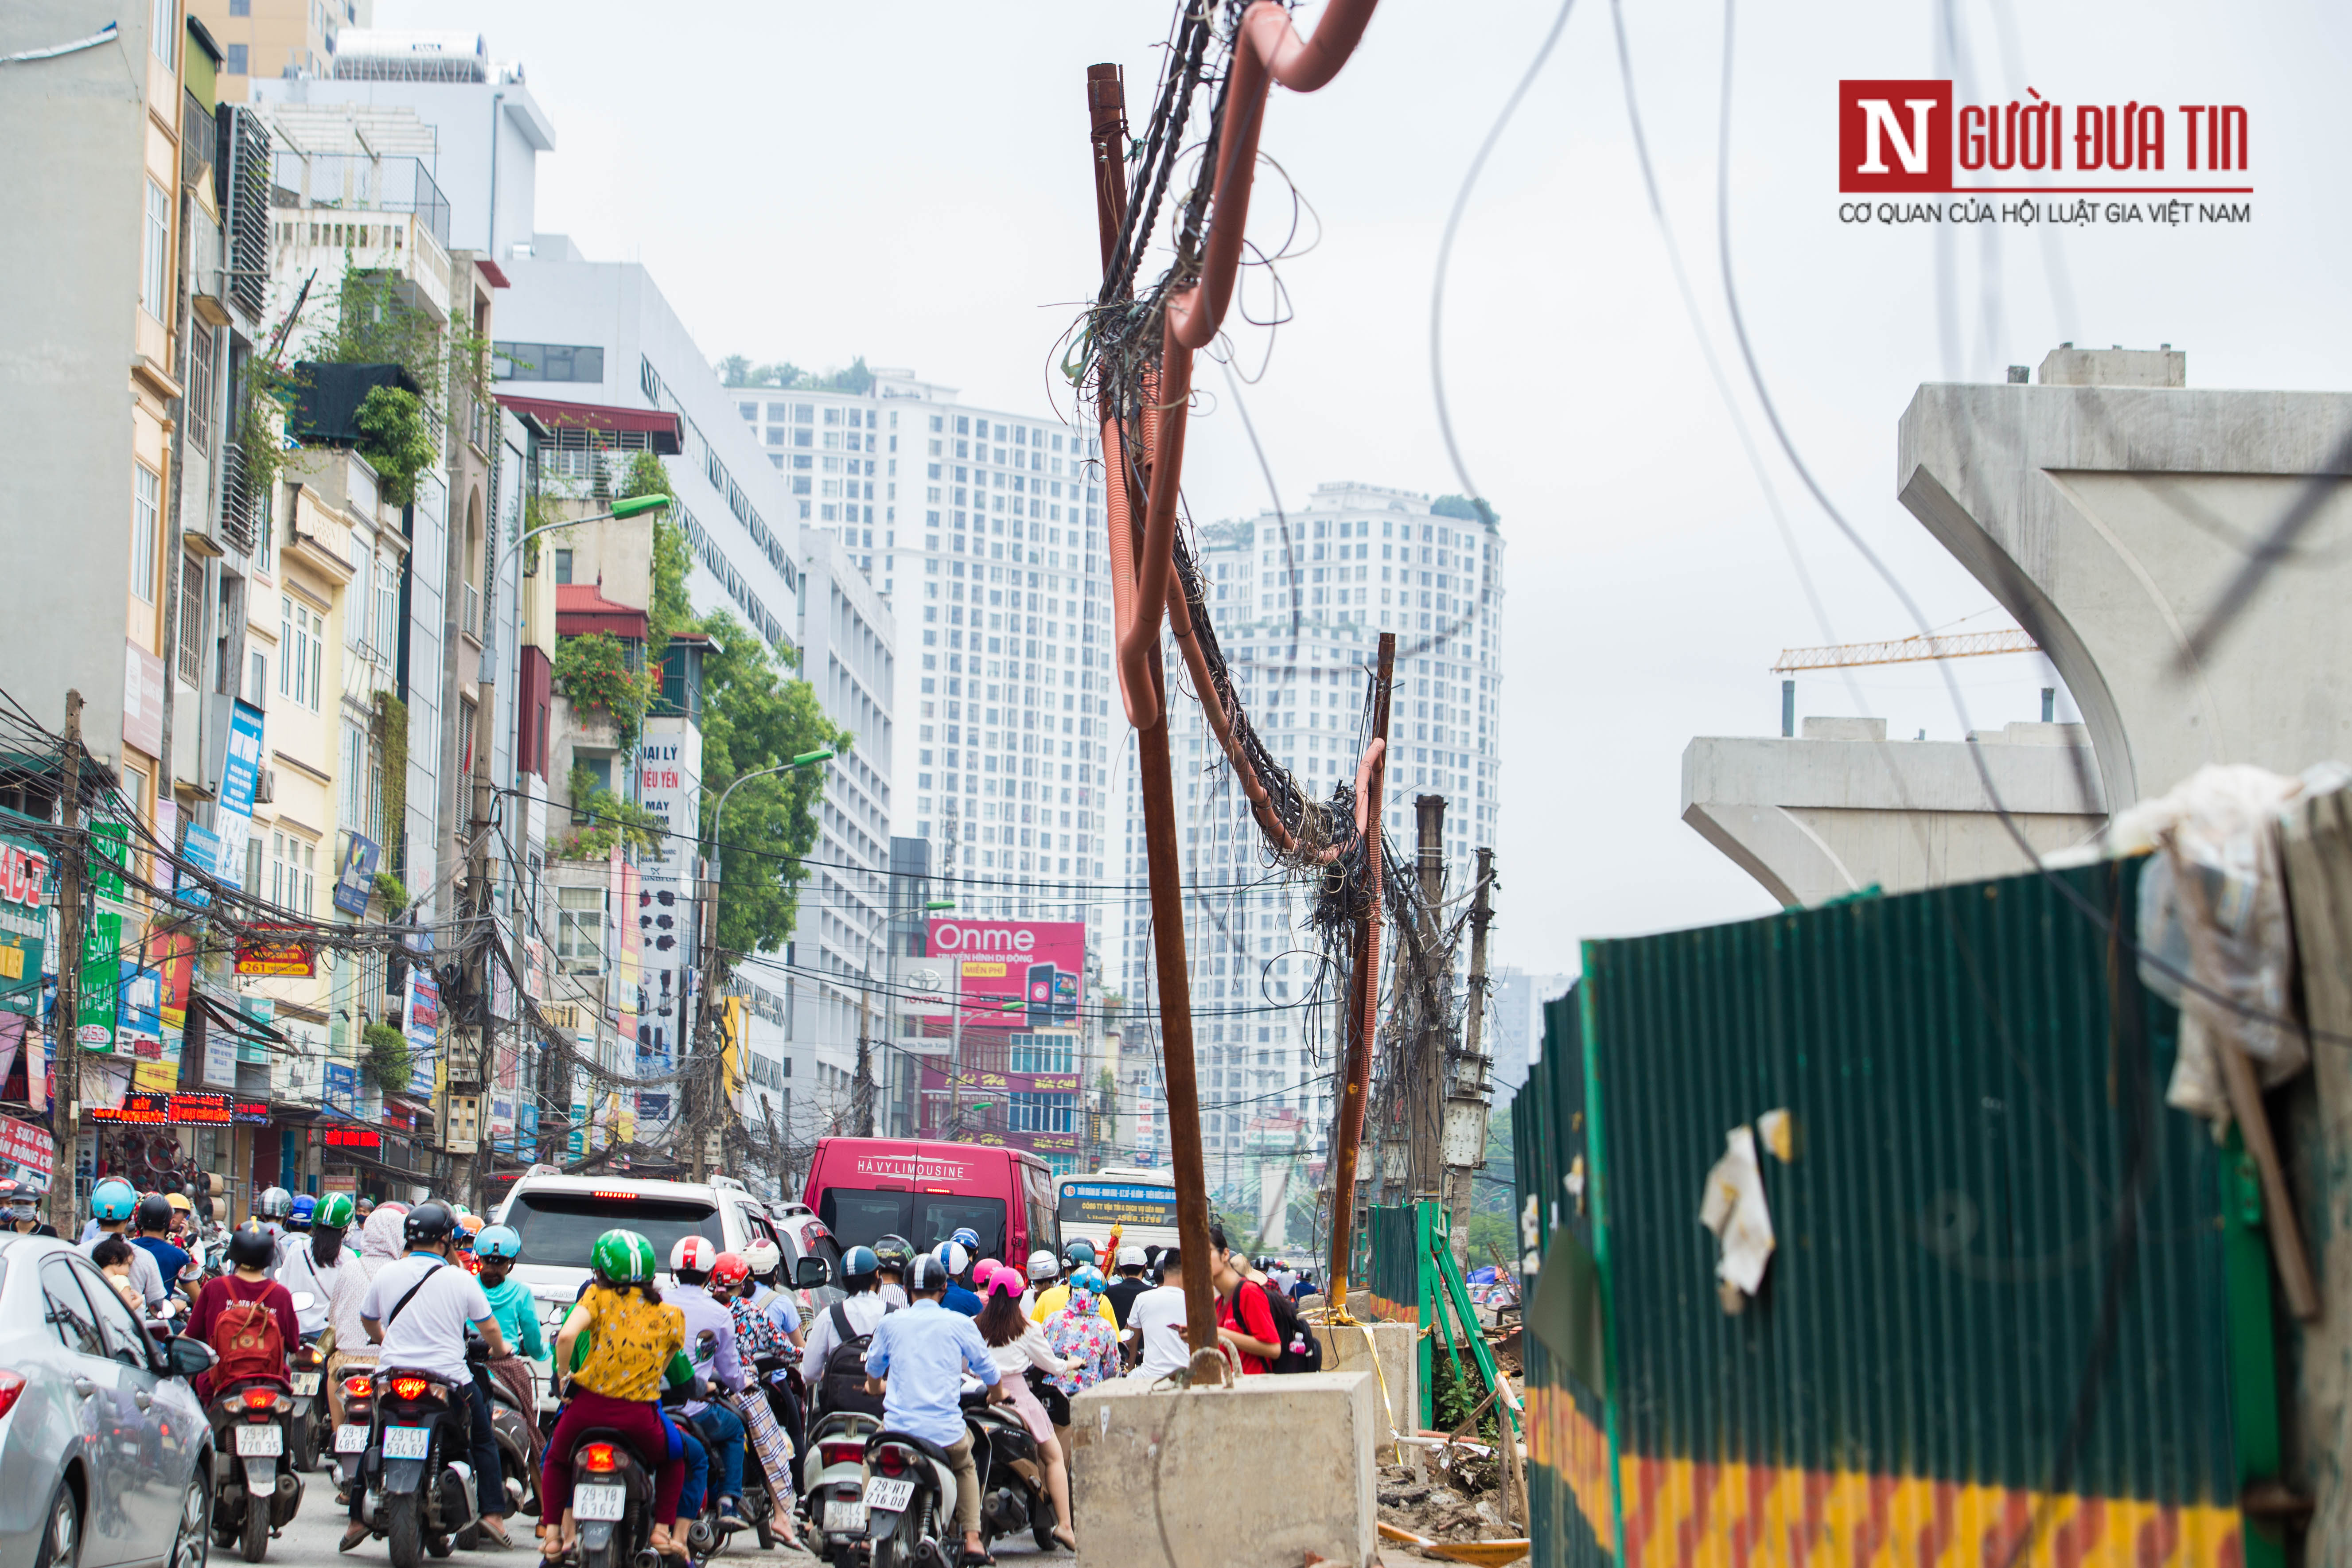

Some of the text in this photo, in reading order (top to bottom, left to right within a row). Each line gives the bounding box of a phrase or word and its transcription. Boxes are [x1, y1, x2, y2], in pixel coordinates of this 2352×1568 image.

[935, 923, 1035, 952] Onme
[972, 953, 994, 961] HÌNH
[1006, 953, 1034, 964] ĐỘNG
[245, 963, 265, 972] 261
[964, 964, 1003, 974] MIỀN PHÍ
[905, 996, 944, 1005] TOYOTA
[857, 1159, 964, 1178] HÀ VY LIMOUSINE
[1065, 1187, 1075, 1195] 19
[1082, 1201, 1096, 1210] CÔNG
[1118, 1214, 1161, 1224] 1900.1296
[244, 1428, 274, 1440] 29-P1
[392, 1428, 422, 1442] 29-C1
[241, 1441, 279, 1454] 720.35
[386, 1442, 425, 1456] 534.62
[582, 1487, 617, 1502] 29-Y8
[867, 1492, 905, 1507] 216.00
[581, 1502, 615, 1517] 6364
